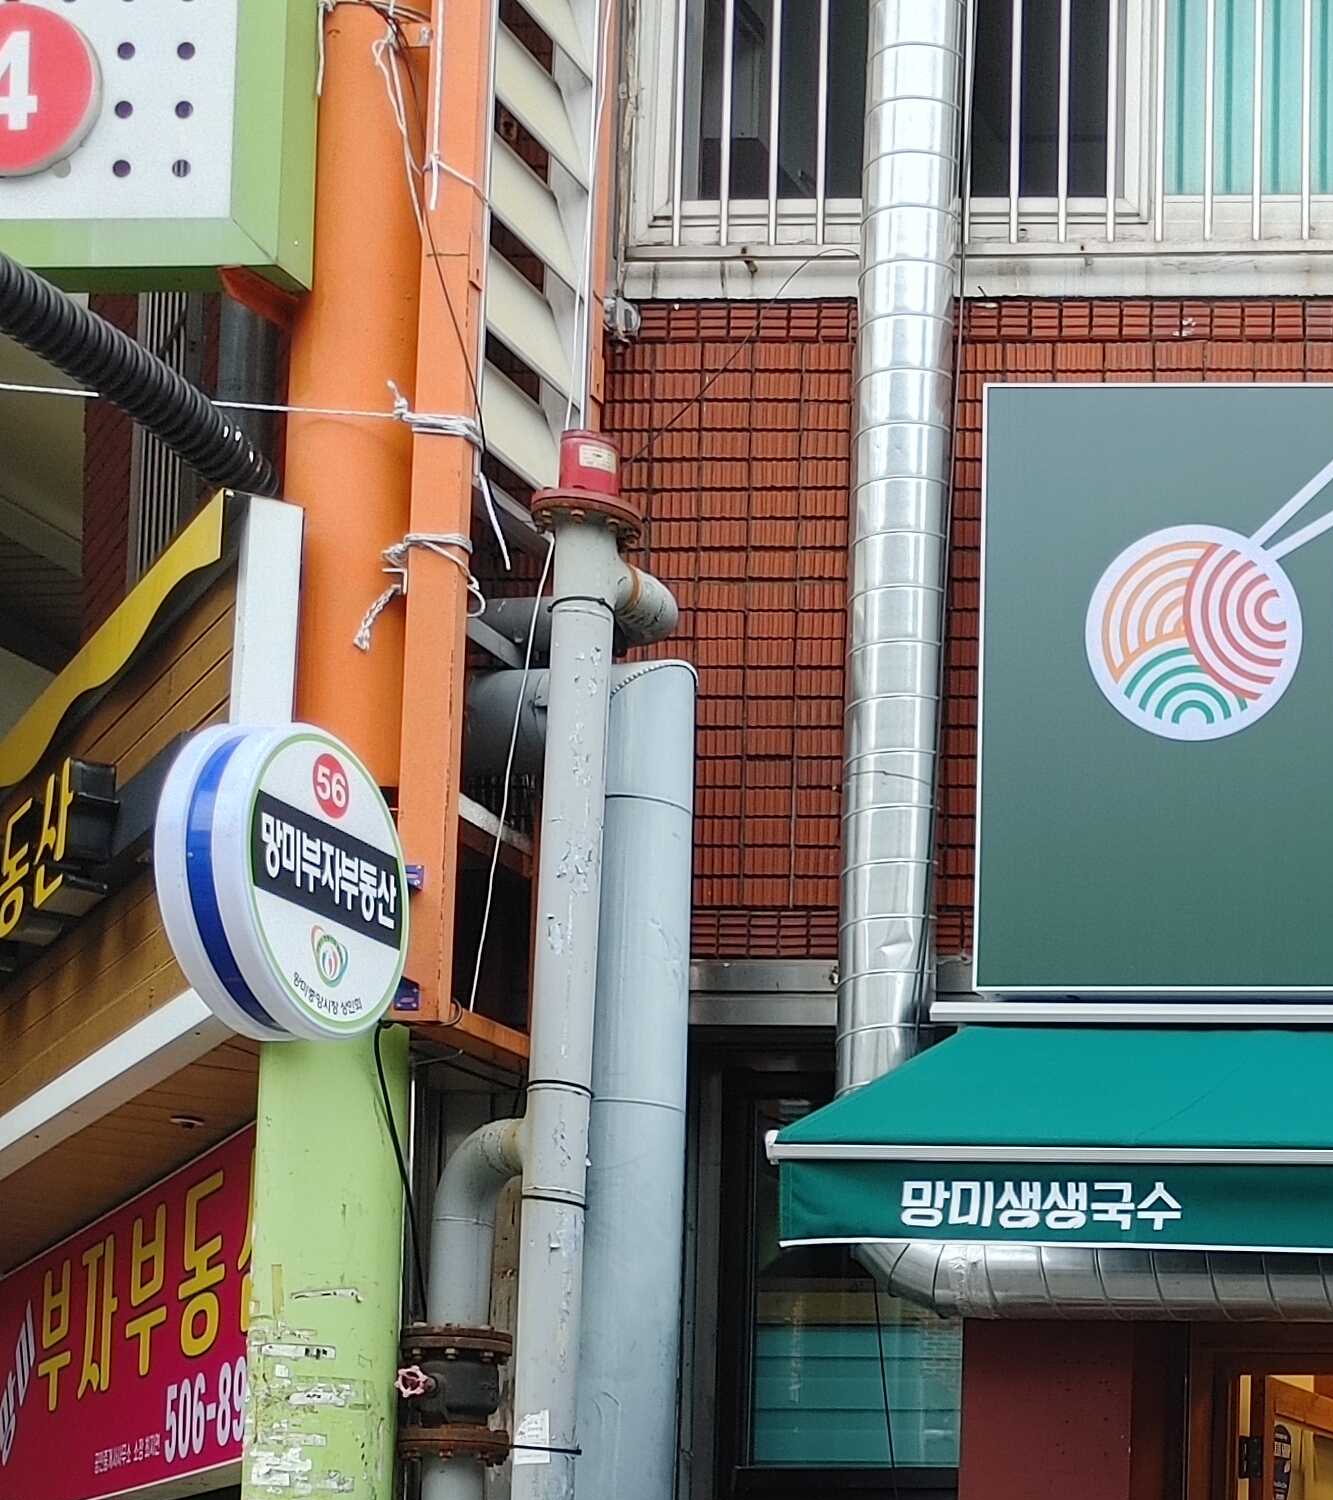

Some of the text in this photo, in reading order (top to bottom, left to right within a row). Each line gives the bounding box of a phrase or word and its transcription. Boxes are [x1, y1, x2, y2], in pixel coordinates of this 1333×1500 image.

[316, 764, 346, 808] 56
[261, 811, 398, 930] 망미부자부동산
[901, 1180, 1182, 1231] 망미생생국수
